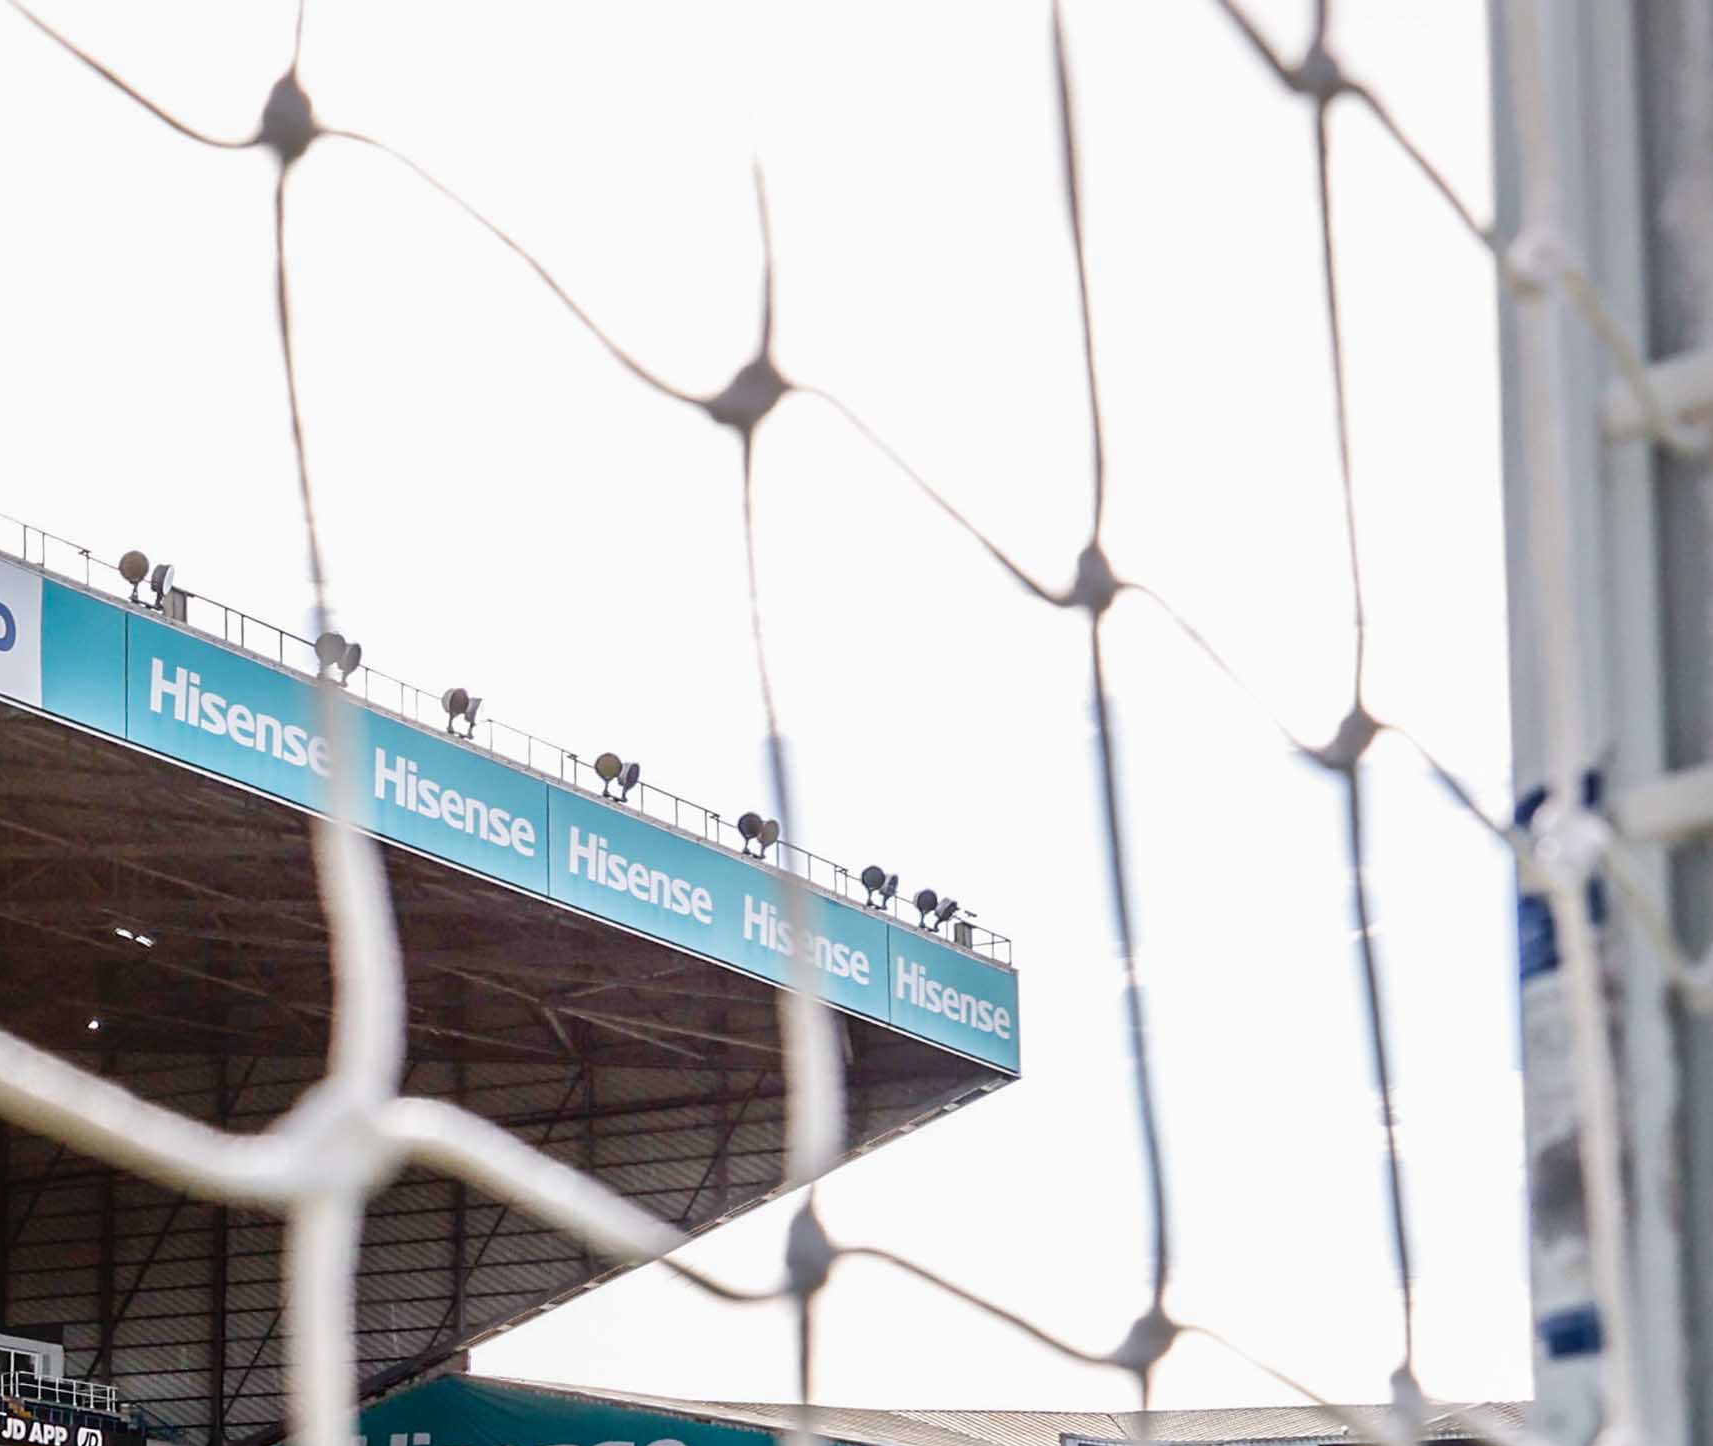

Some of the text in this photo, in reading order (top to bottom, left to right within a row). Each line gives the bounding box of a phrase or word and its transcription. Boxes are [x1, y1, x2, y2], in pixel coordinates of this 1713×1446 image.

[149, 657, 333, 777] Hisense
[374, 747, 536, 857] Hisense
[569, 825, 713, 926] Hisense
[895, 956, 1011, 1039] Hisense
[1, 1418, 26, 1441] JD
[29, 1422, 67, 1446] APP
